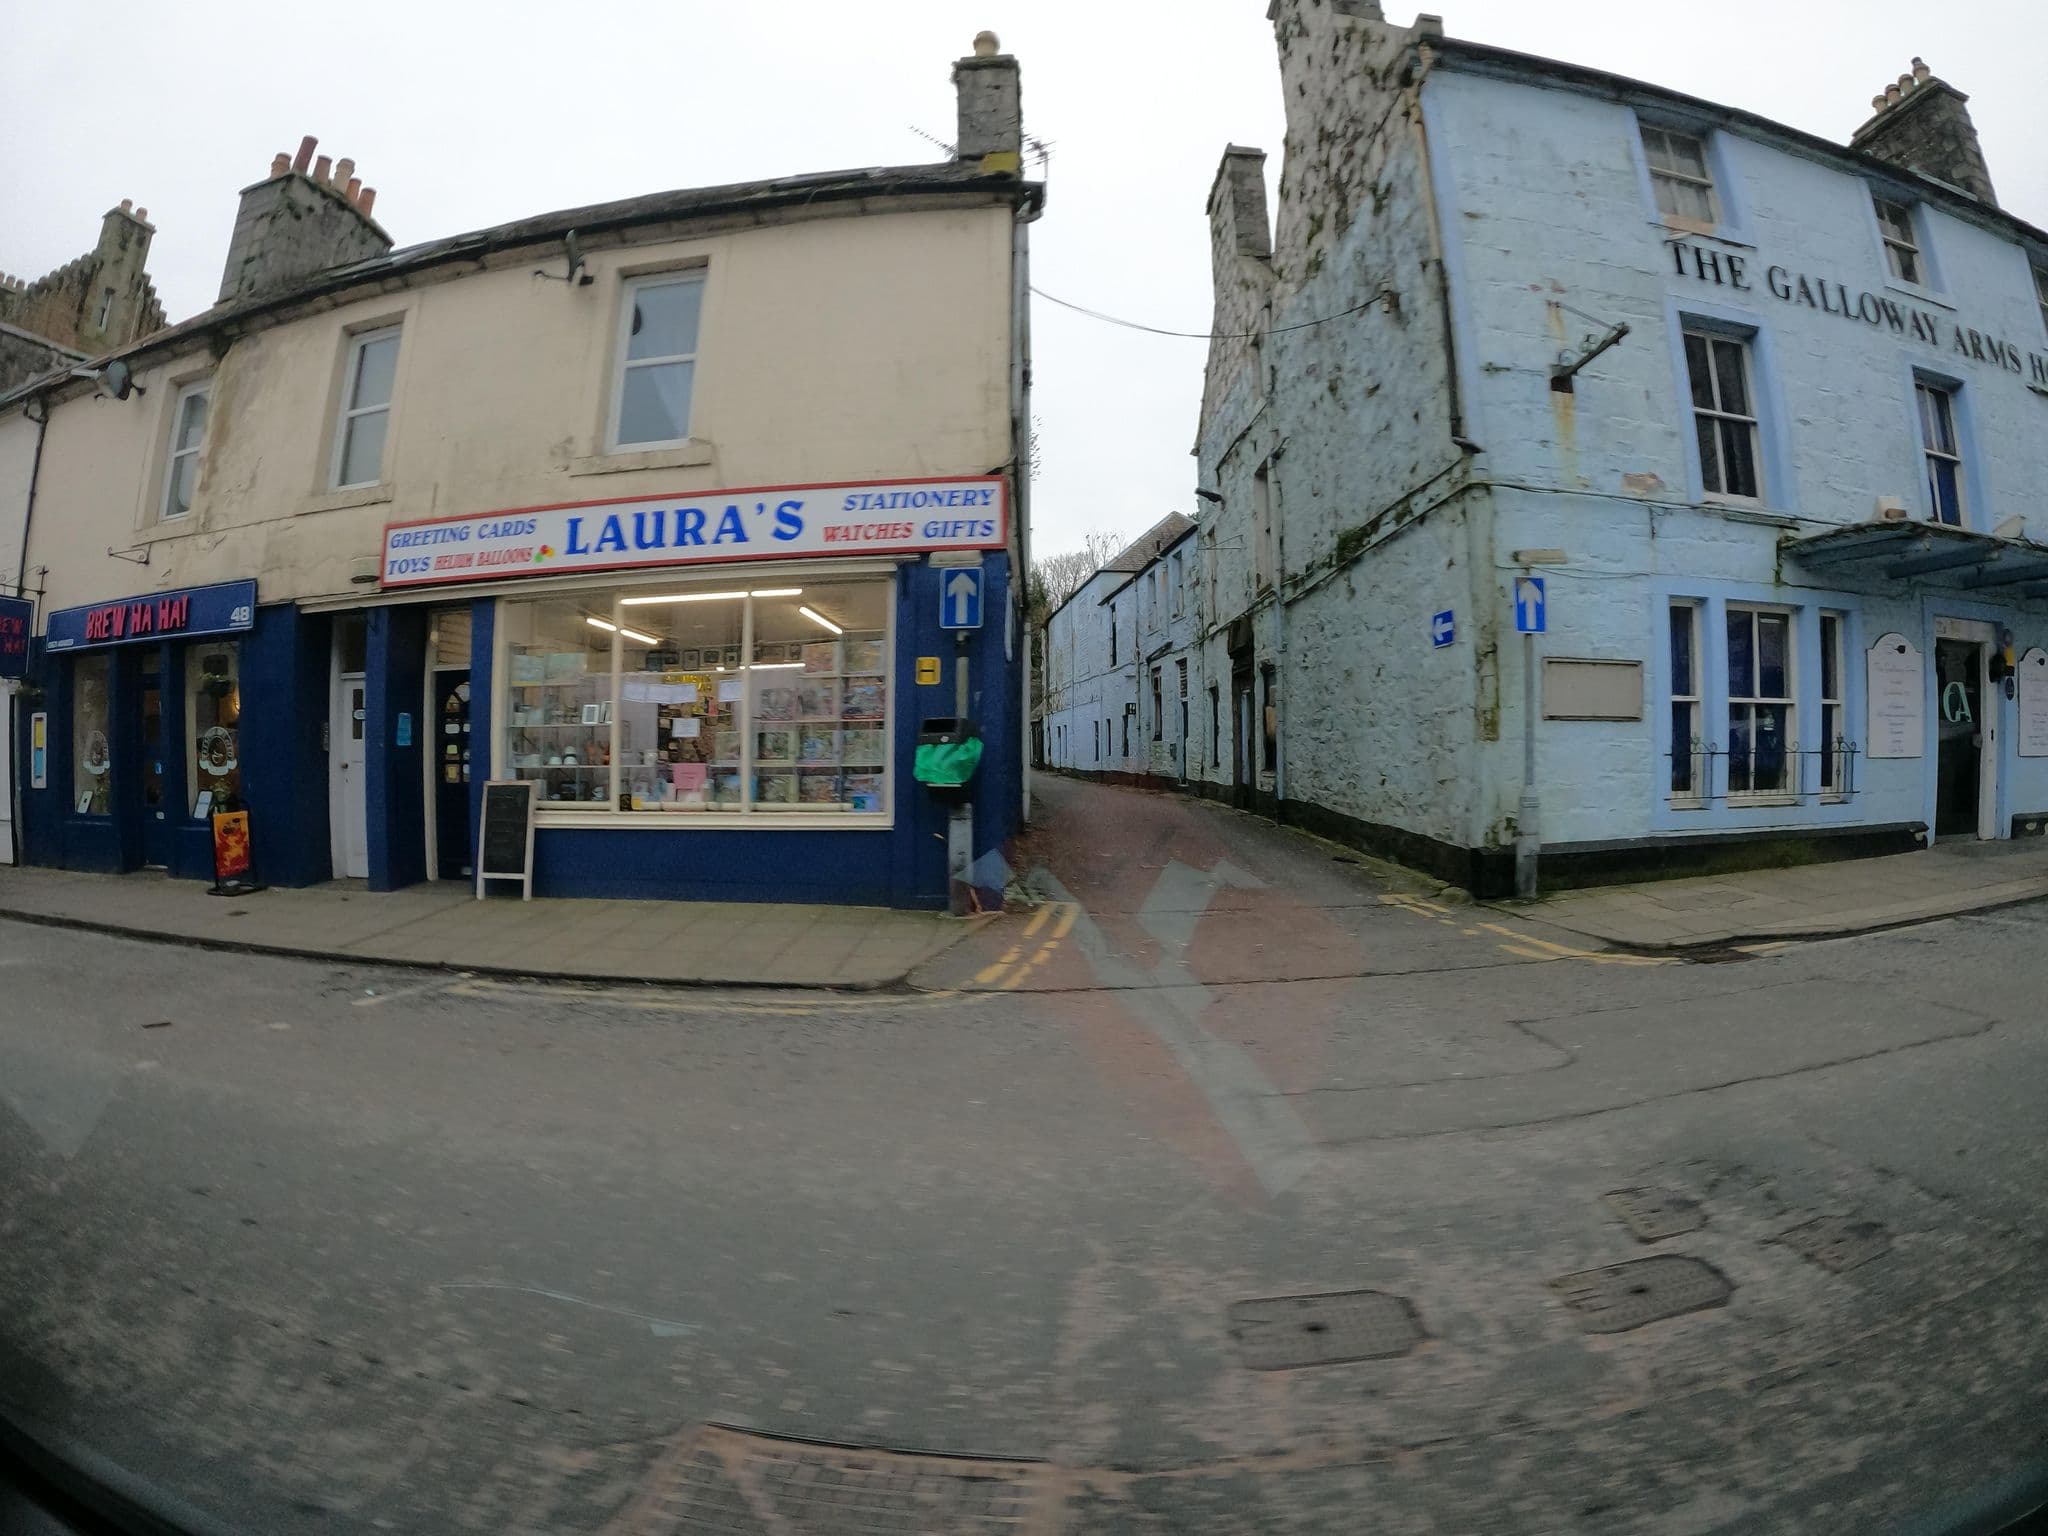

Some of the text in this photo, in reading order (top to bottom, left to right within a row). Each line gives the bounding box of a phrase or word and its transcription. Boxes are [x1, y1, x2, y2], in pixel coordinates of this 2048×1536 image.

[1663, 239, 2048, 384] THE GALLOWAY ARMS H
[842, 488, 996, 511] STATIONERY
[390, 518, 537, 550] GREETING CARDS
[564, 499, 805, 556] LAURA'S
[823, 519, 996, 543] WATCHES GIFTS
[388, 547, 534, 576] TOYS HELIUM BALLOONS
[85, 594, 188, 640] BREW HA HA!
